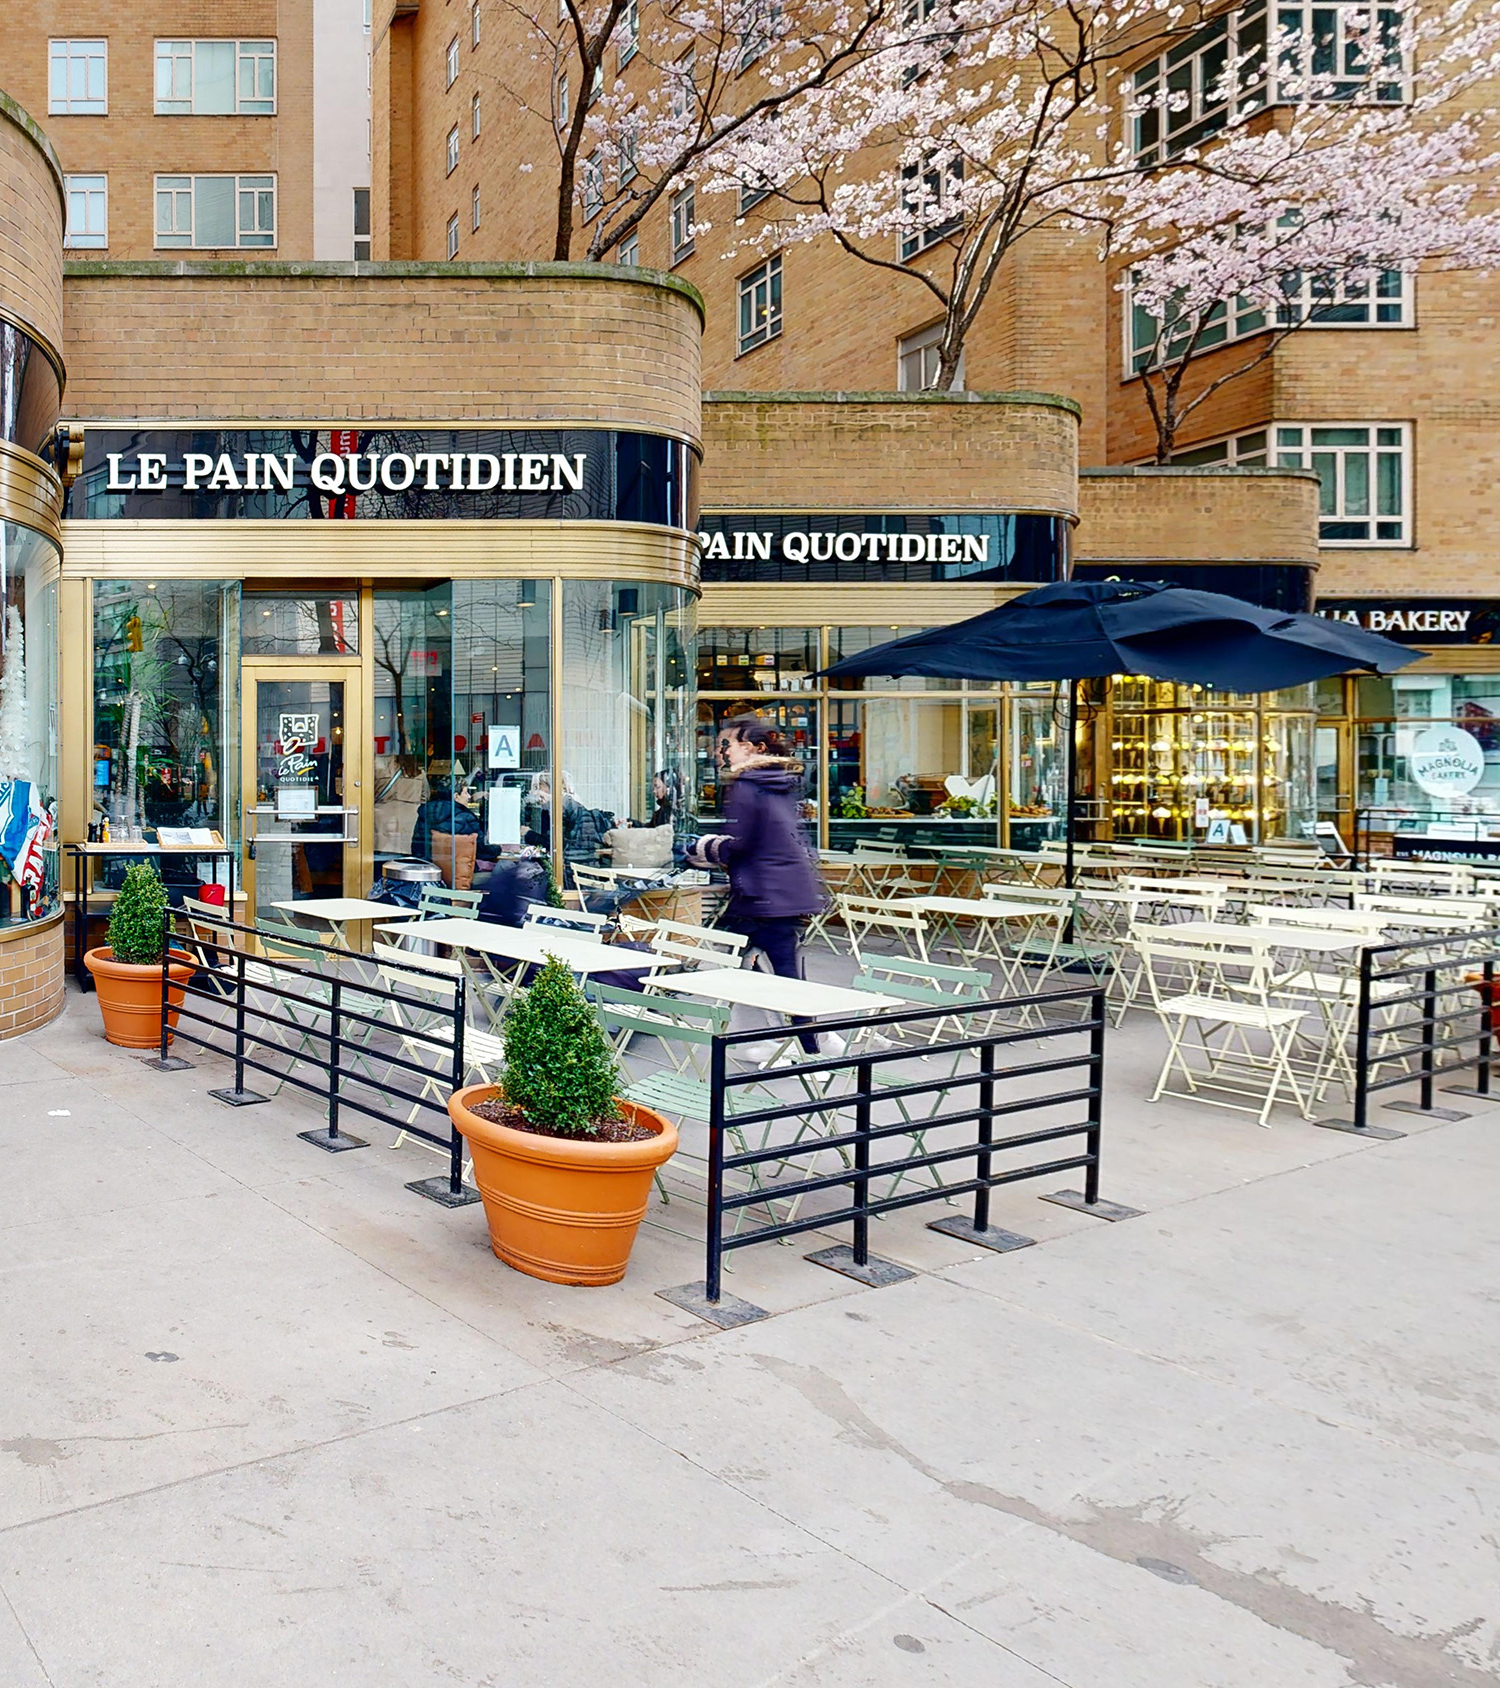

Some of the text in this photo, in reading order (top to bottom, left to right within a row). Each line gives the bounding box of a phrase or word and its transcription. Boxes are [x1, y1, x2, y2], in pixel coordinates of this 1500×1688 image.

[106, 452, 587, 496] LE PAIN QUOTIDIEN
[782, 532, 991, 565] QUOTIDIEN
[1369, 610, 1471, 632] BAKERY
[494, 734, 514, 757] A
[1212, 823, 1224, 836] A
